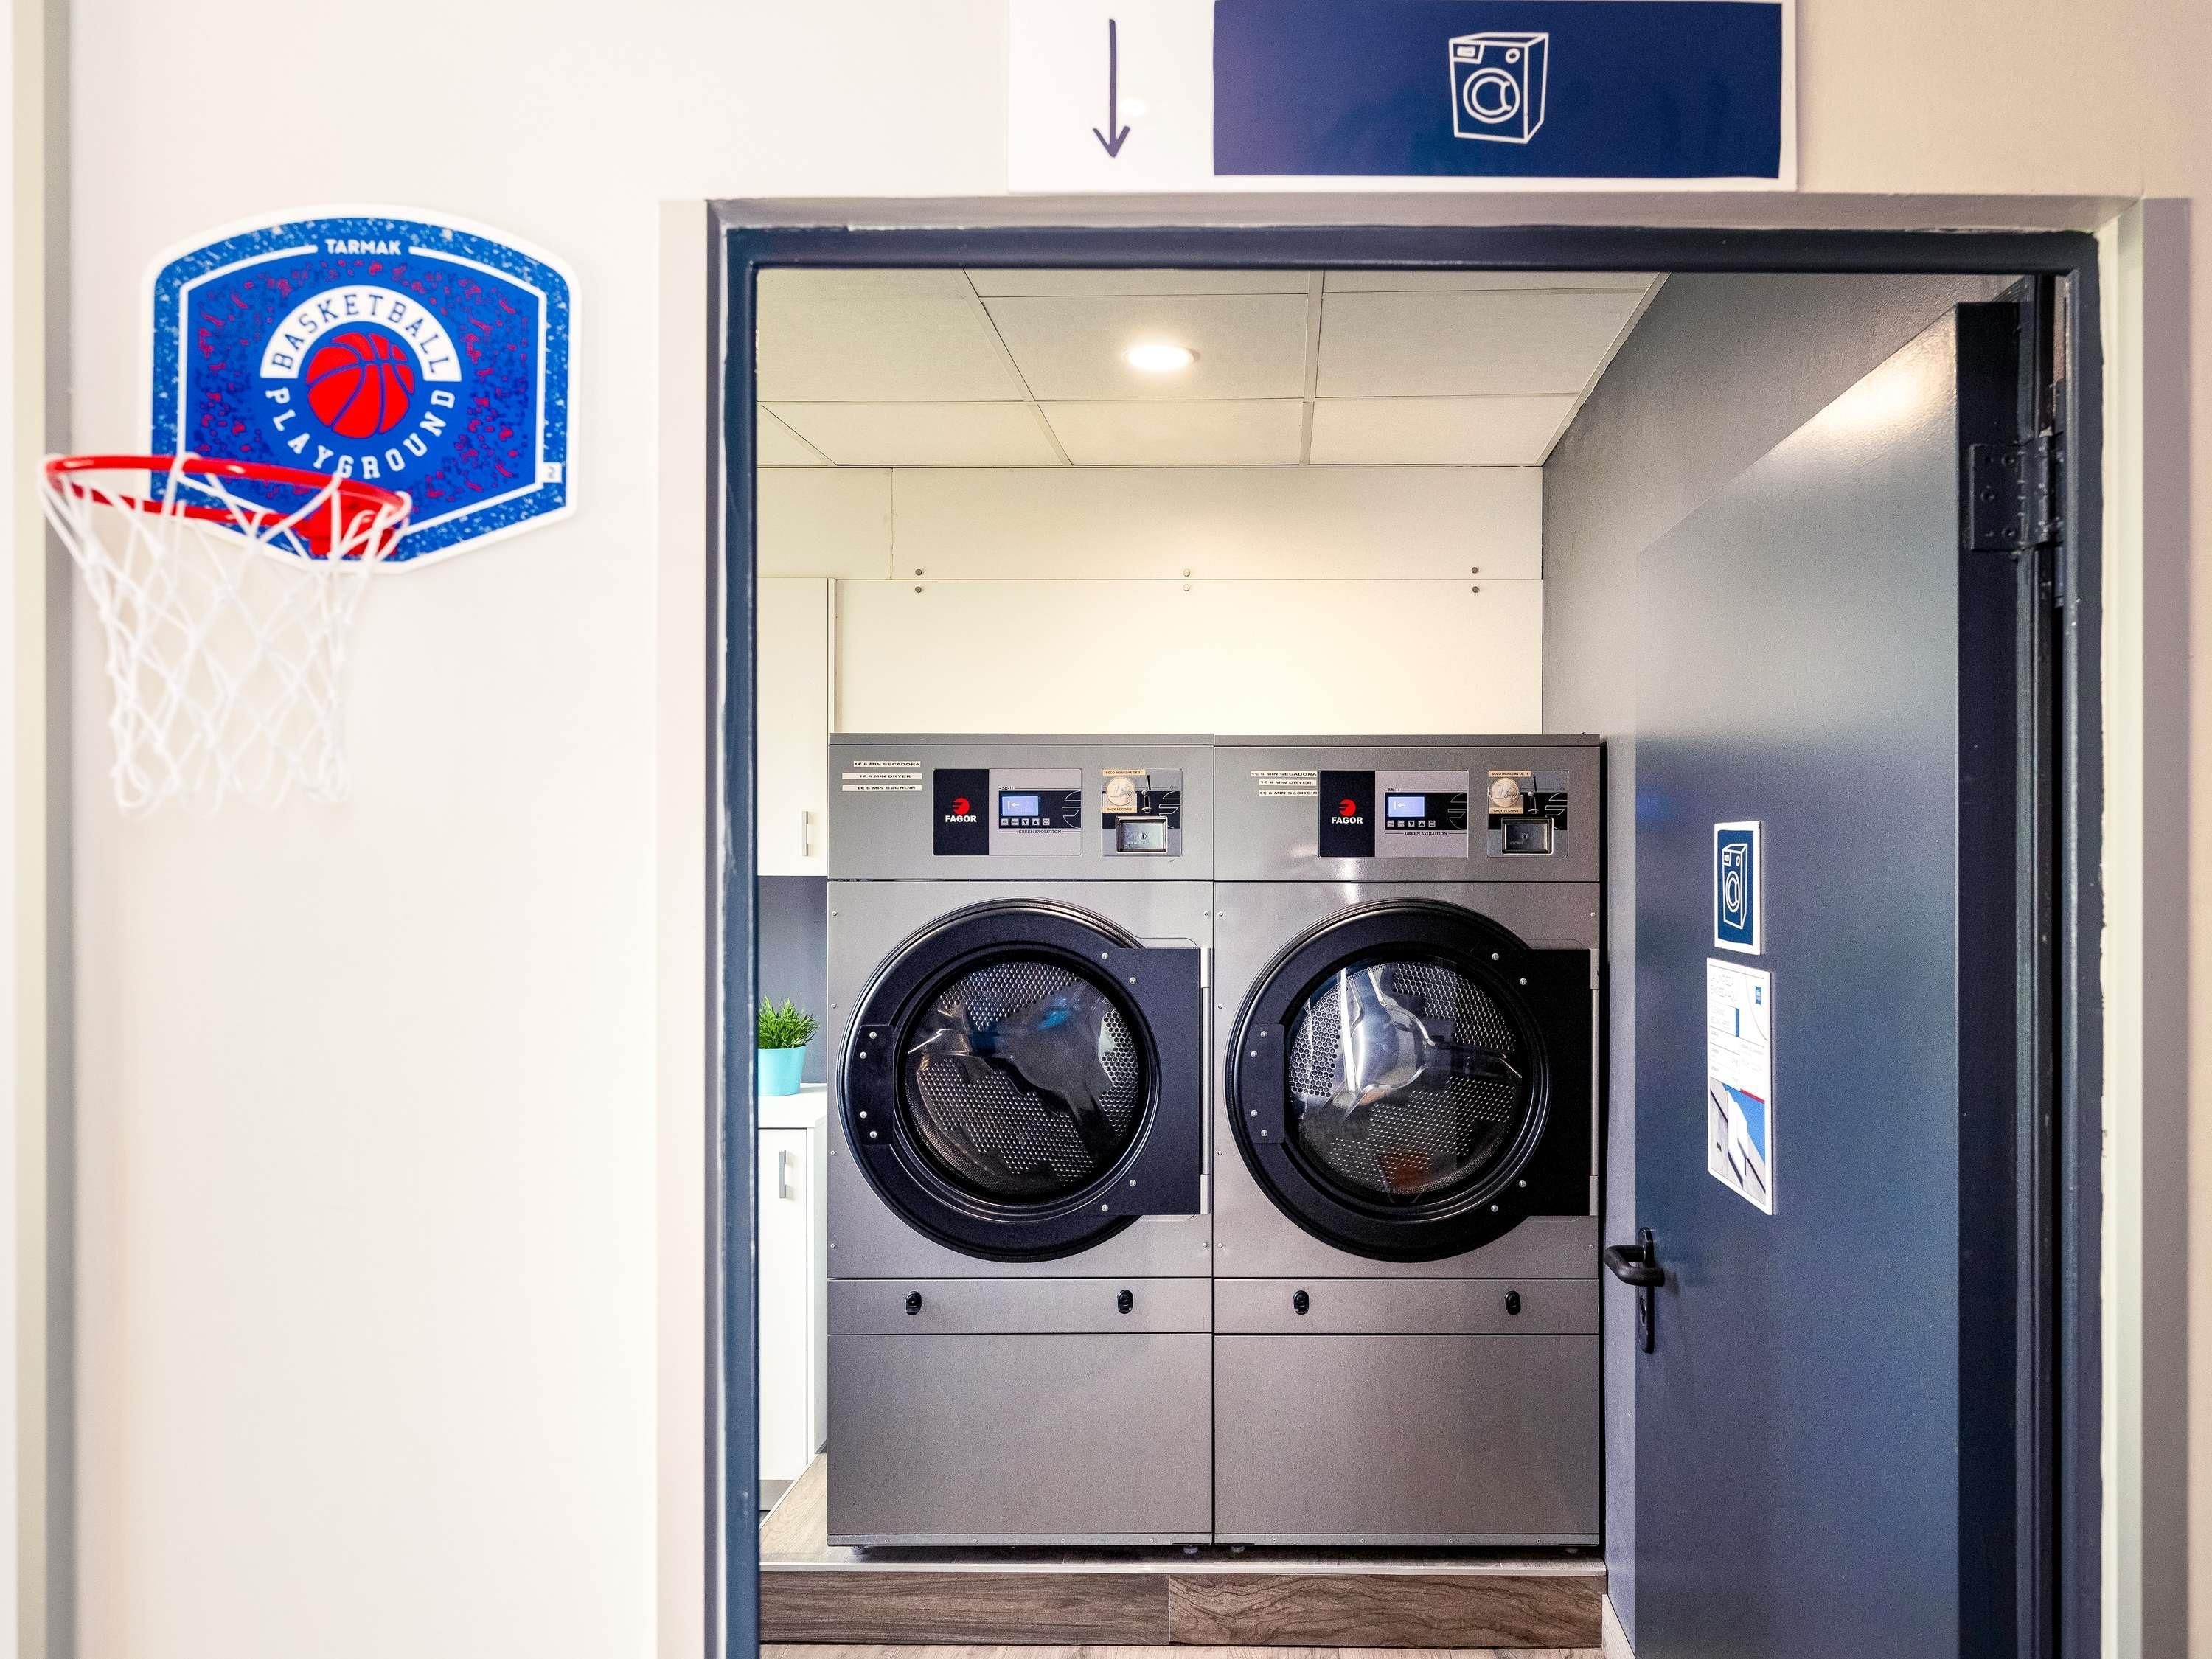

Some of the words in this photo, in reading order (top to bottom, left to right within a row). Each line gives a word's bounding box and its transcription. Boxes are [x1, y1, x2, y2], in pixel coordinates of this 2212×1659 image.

[324, 238, 402, 256] TARMAK
[271, 293, 450, 375] BASKETBALL
[265, 386, 456, 480] PLAYGROUND
[1331, 816, 1363, 824] FAGOR
